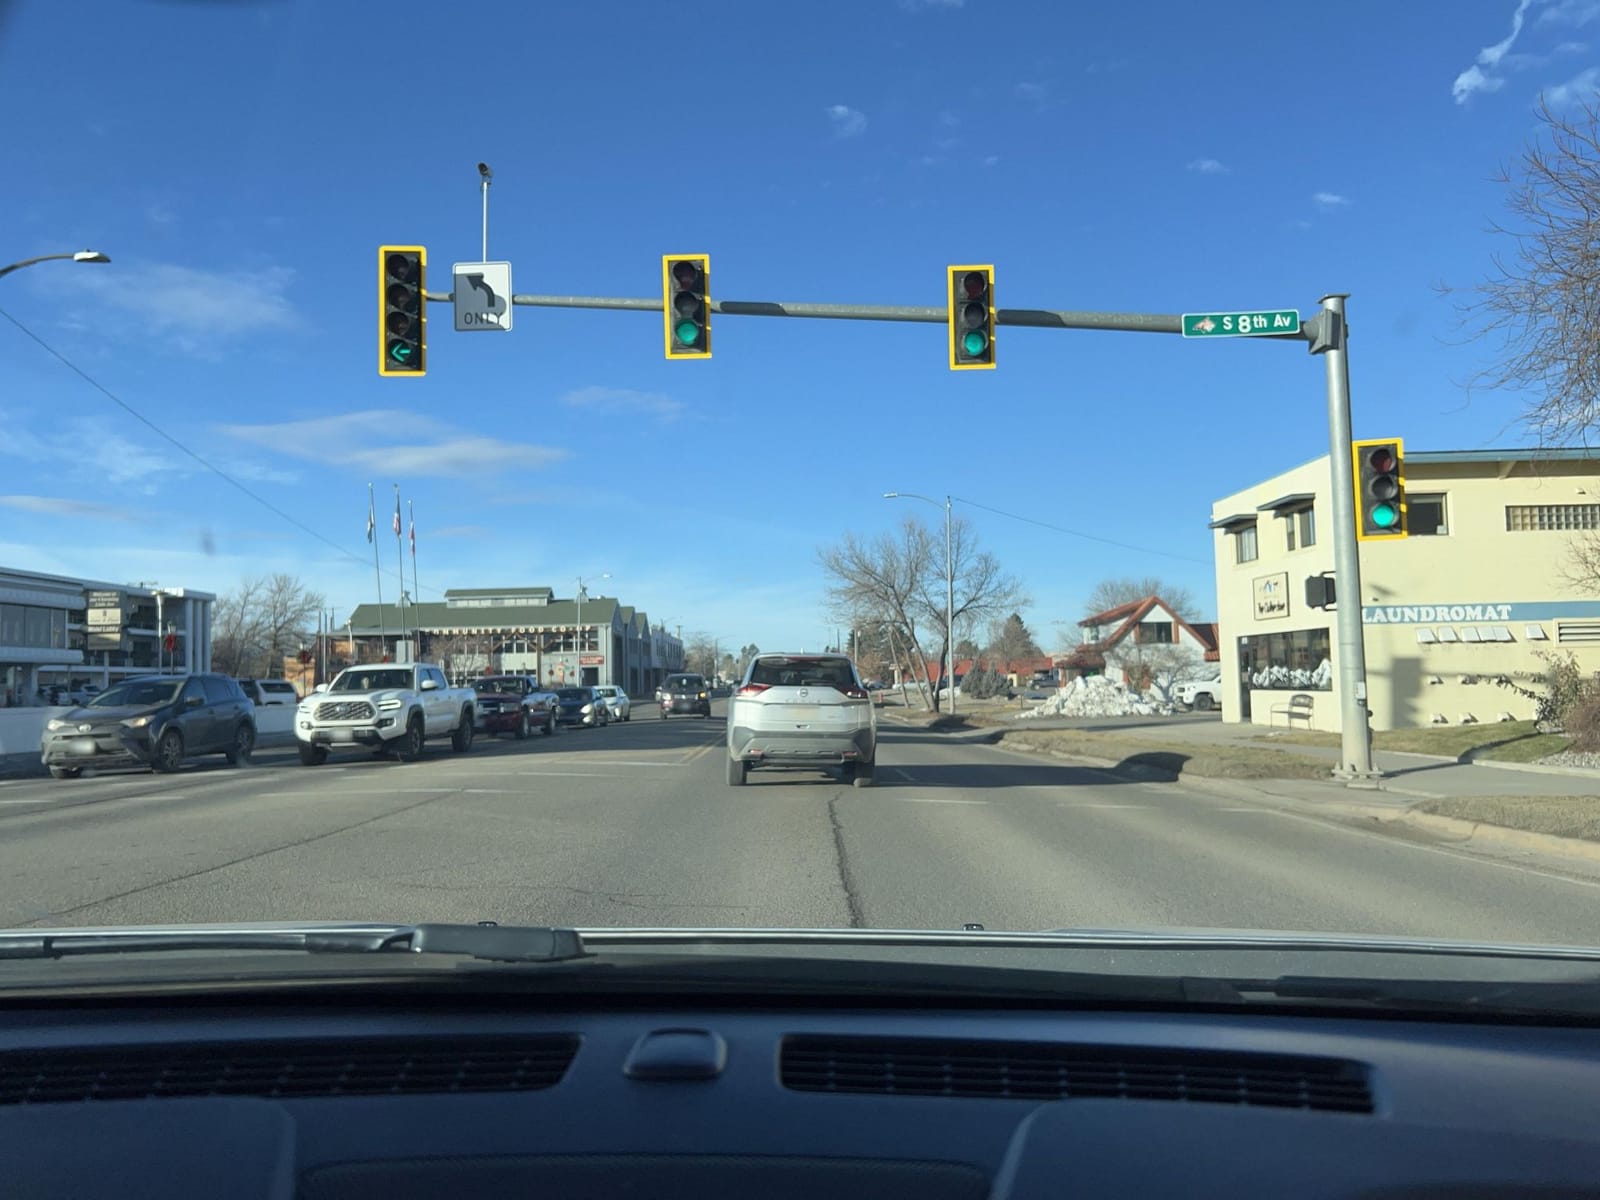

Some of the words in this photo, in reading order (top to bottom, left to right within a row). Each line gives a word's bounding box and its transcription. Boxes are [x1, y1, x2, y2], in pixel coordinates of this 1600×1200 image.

[464, 312, 501, 325] ONLY
[1222, 316, 1233, 330] S
[1238, 315, 1267, 333] 8th
[1273, 314, 1291, 327] Av
[1362, 605, 1512, 623] LAUNDROMAT
[511, 626, 544, 634] FOOD
